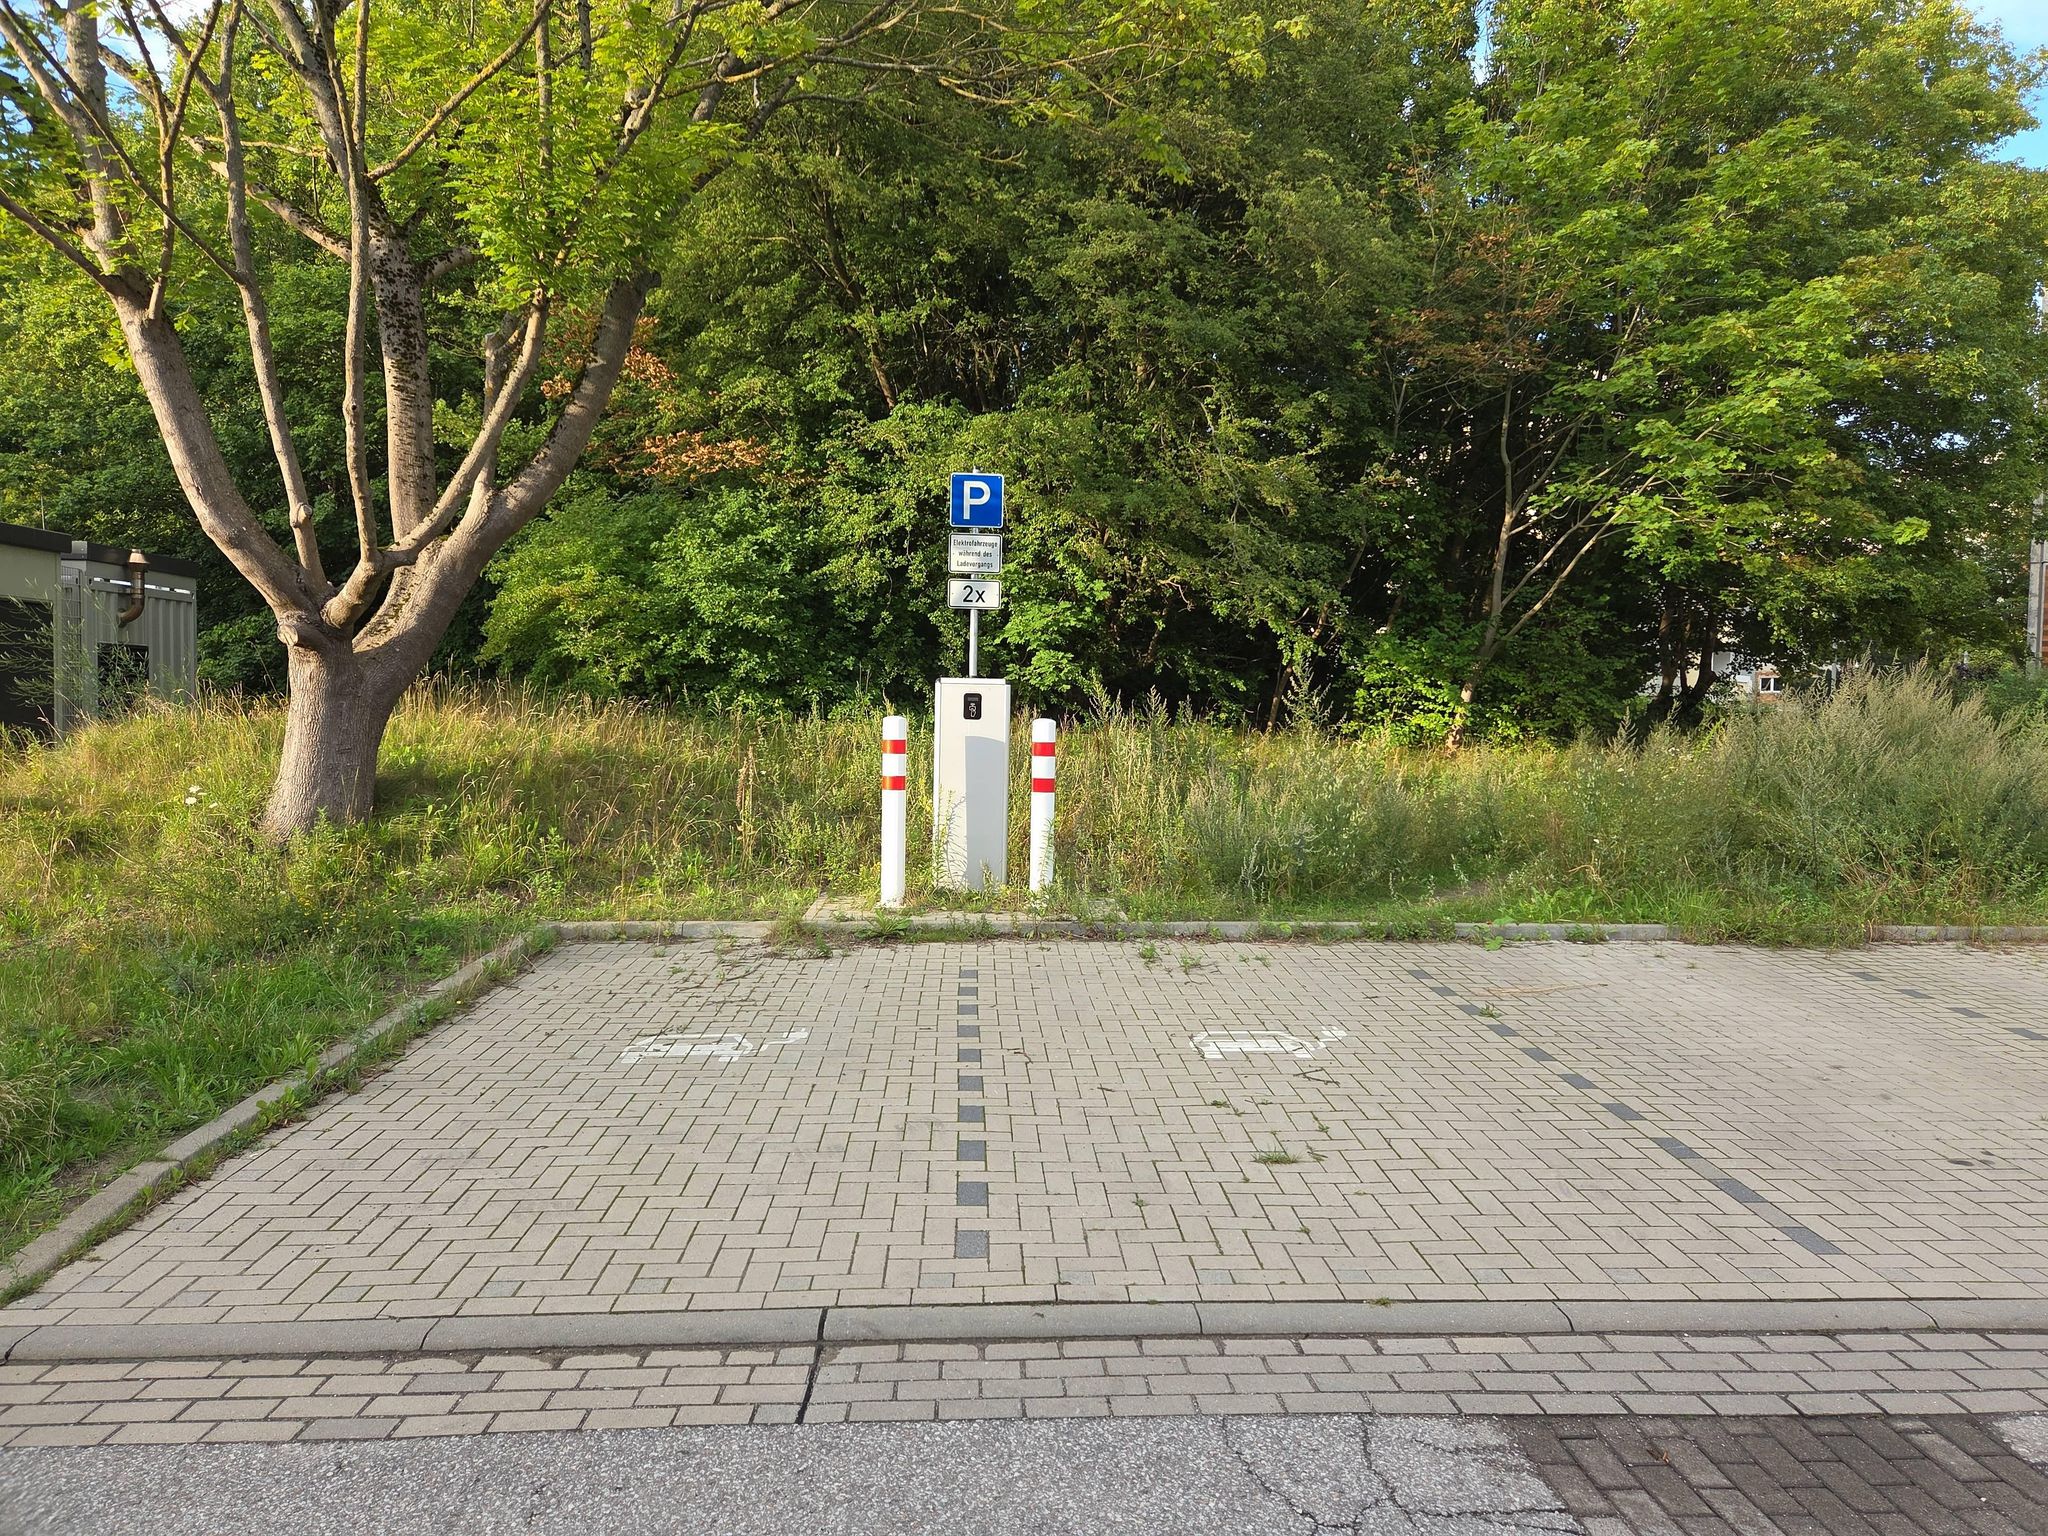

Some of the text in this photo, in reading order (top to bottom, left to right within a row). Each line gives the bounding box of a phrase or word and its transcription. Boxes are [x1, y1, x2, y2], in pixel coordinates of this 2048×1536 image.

[963, 480, 991, 520] P
[953, 539, 998, 549] Elektrofahrzeuge
[956, 560, 993, 569] Ladevorgangs
[962, 584, 986, 603] 2x
